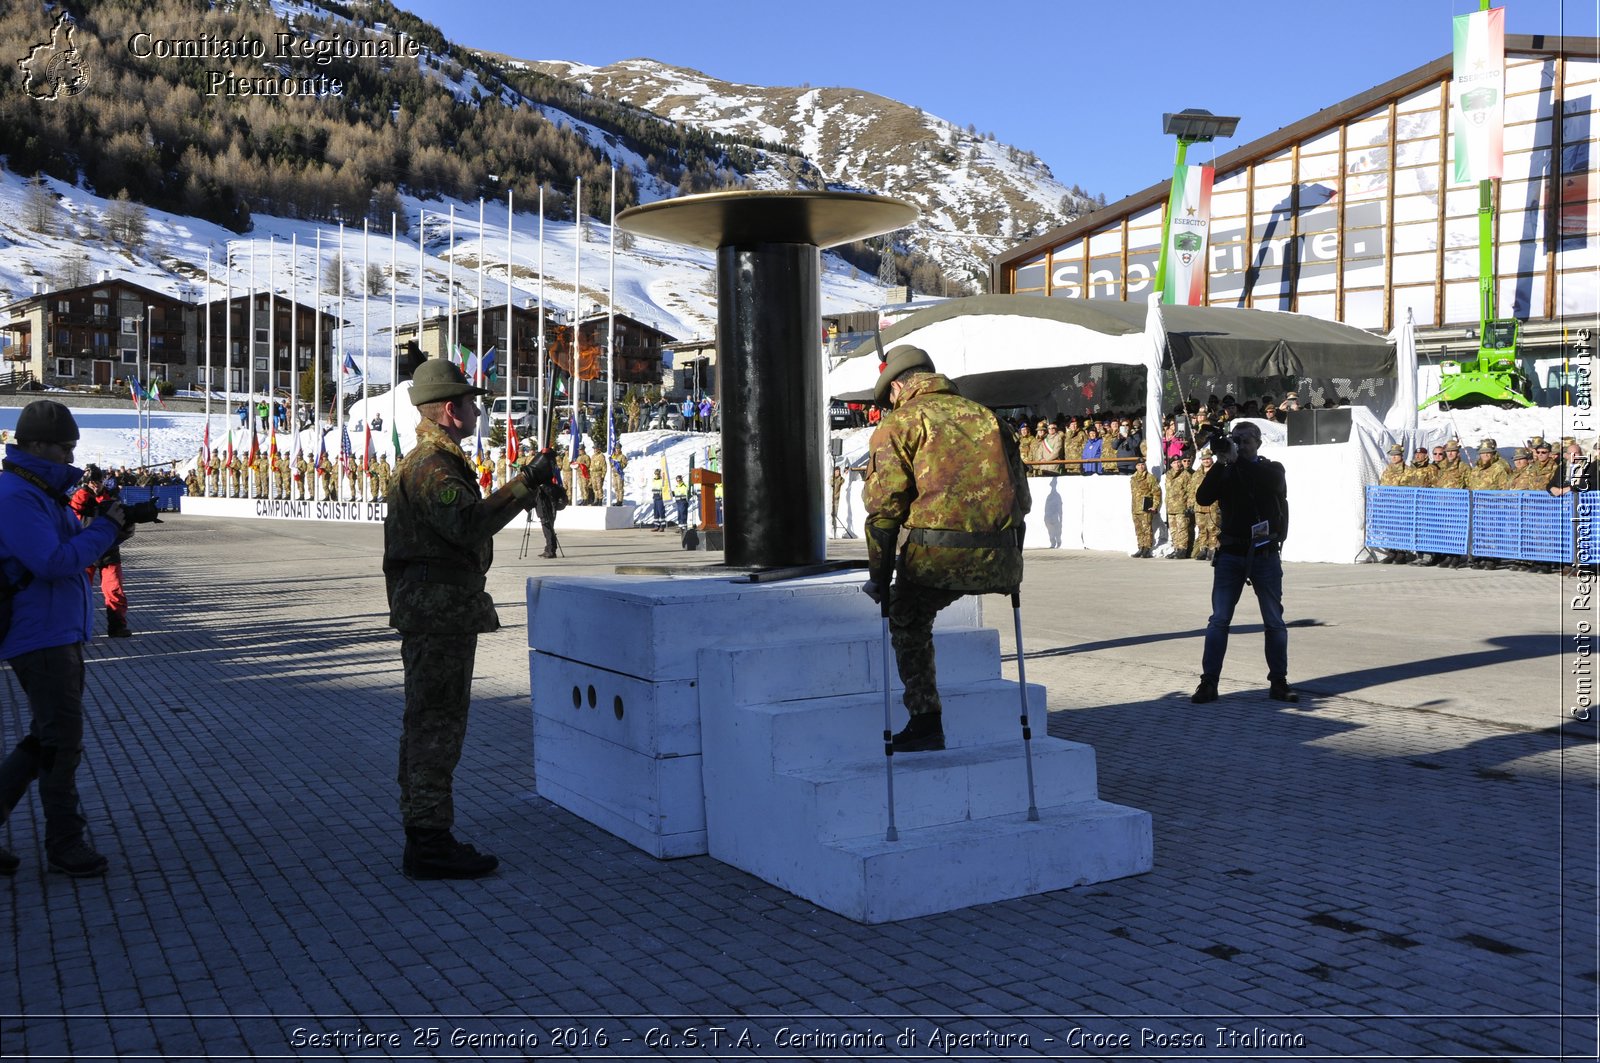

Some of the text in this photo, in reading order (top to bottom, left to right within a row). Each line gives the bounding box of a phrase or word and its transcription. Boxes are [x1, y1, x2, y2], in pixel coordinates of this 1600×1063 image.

[1458, 70, 1500, 83] ESERCITO
[1174, 217, 1207, 227] ESERCITO
[1052, 228, 1366, 299] Snotime.
[256, 500, 312, 519] CAMPIONATI
[316, 502, 361, 521] SCIISTICI
